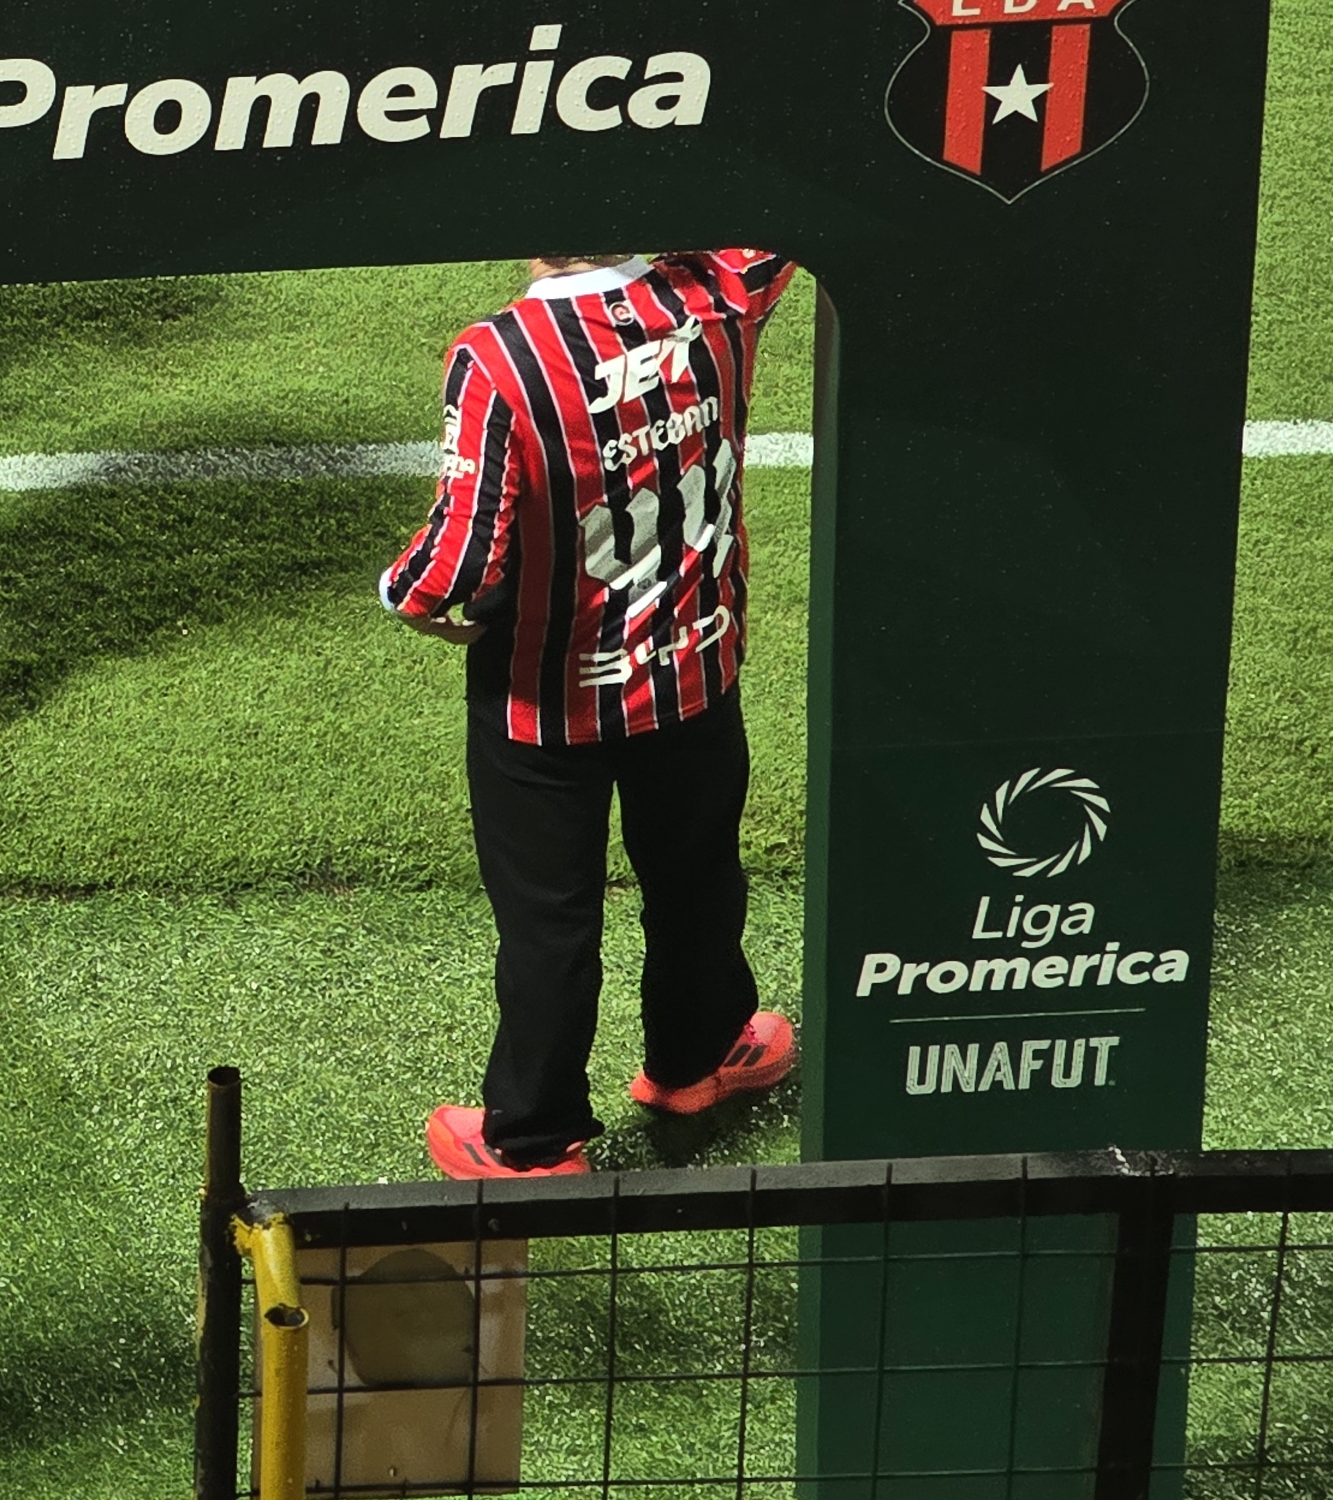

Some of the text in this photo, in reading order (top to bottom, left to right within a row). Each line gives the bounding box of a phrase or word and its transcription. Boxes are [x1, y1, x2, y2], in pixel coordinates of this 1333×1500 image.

[971, 894, 1095, 949] Liga
[855, 940, 1190, 997] Promerica
[905, 1036, 1120, 1095] UNAFUT
